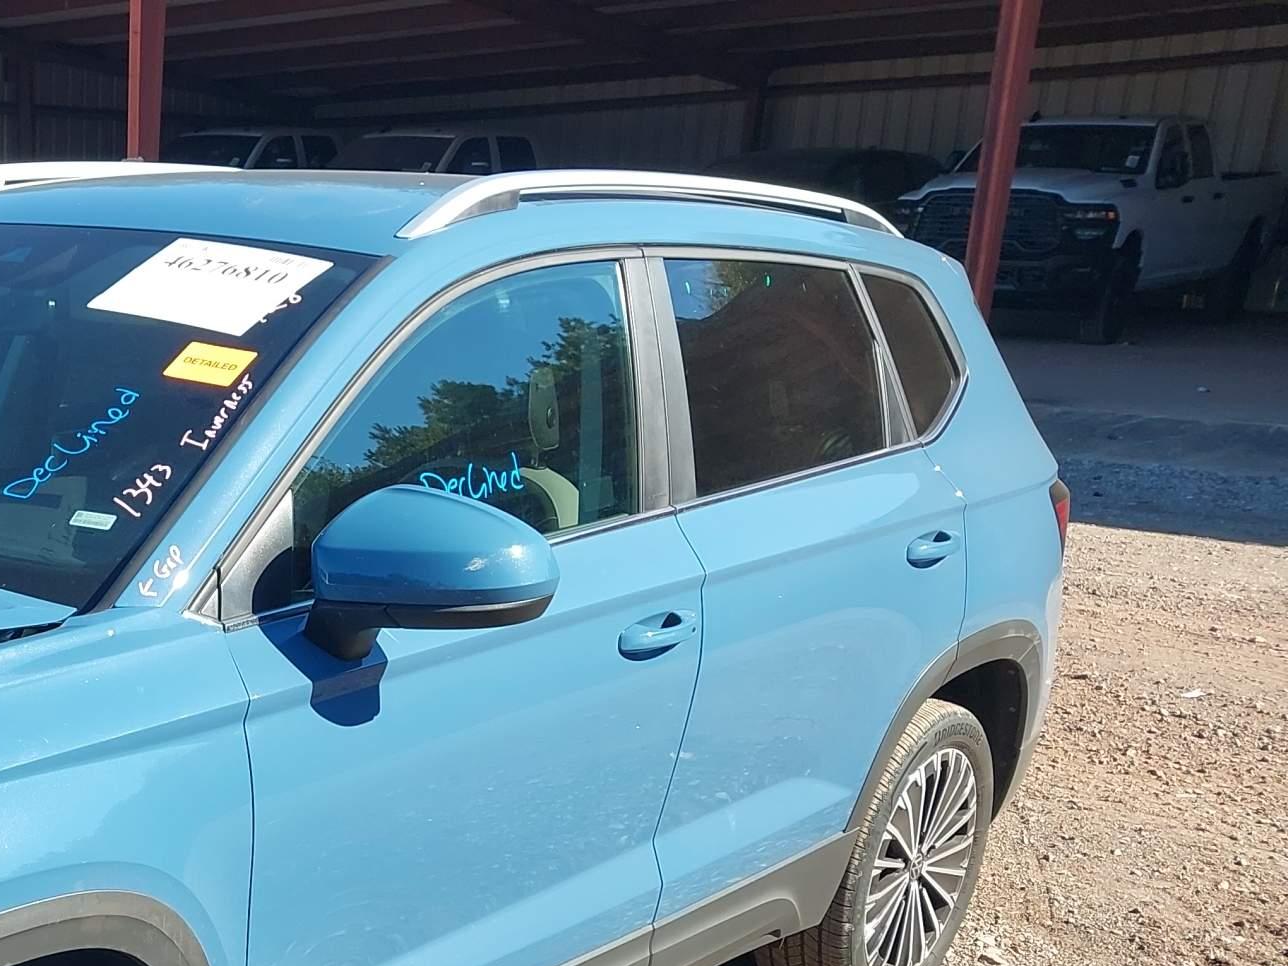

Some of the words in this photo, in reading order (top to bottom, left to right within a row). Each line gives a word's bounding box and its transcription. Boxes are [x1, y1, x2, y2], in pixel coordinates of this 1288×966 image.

[164, 255, 289, 284] 46276810
[183, 356, 238, 372] DETAILED
[113, 464, 172, 518] 1343
